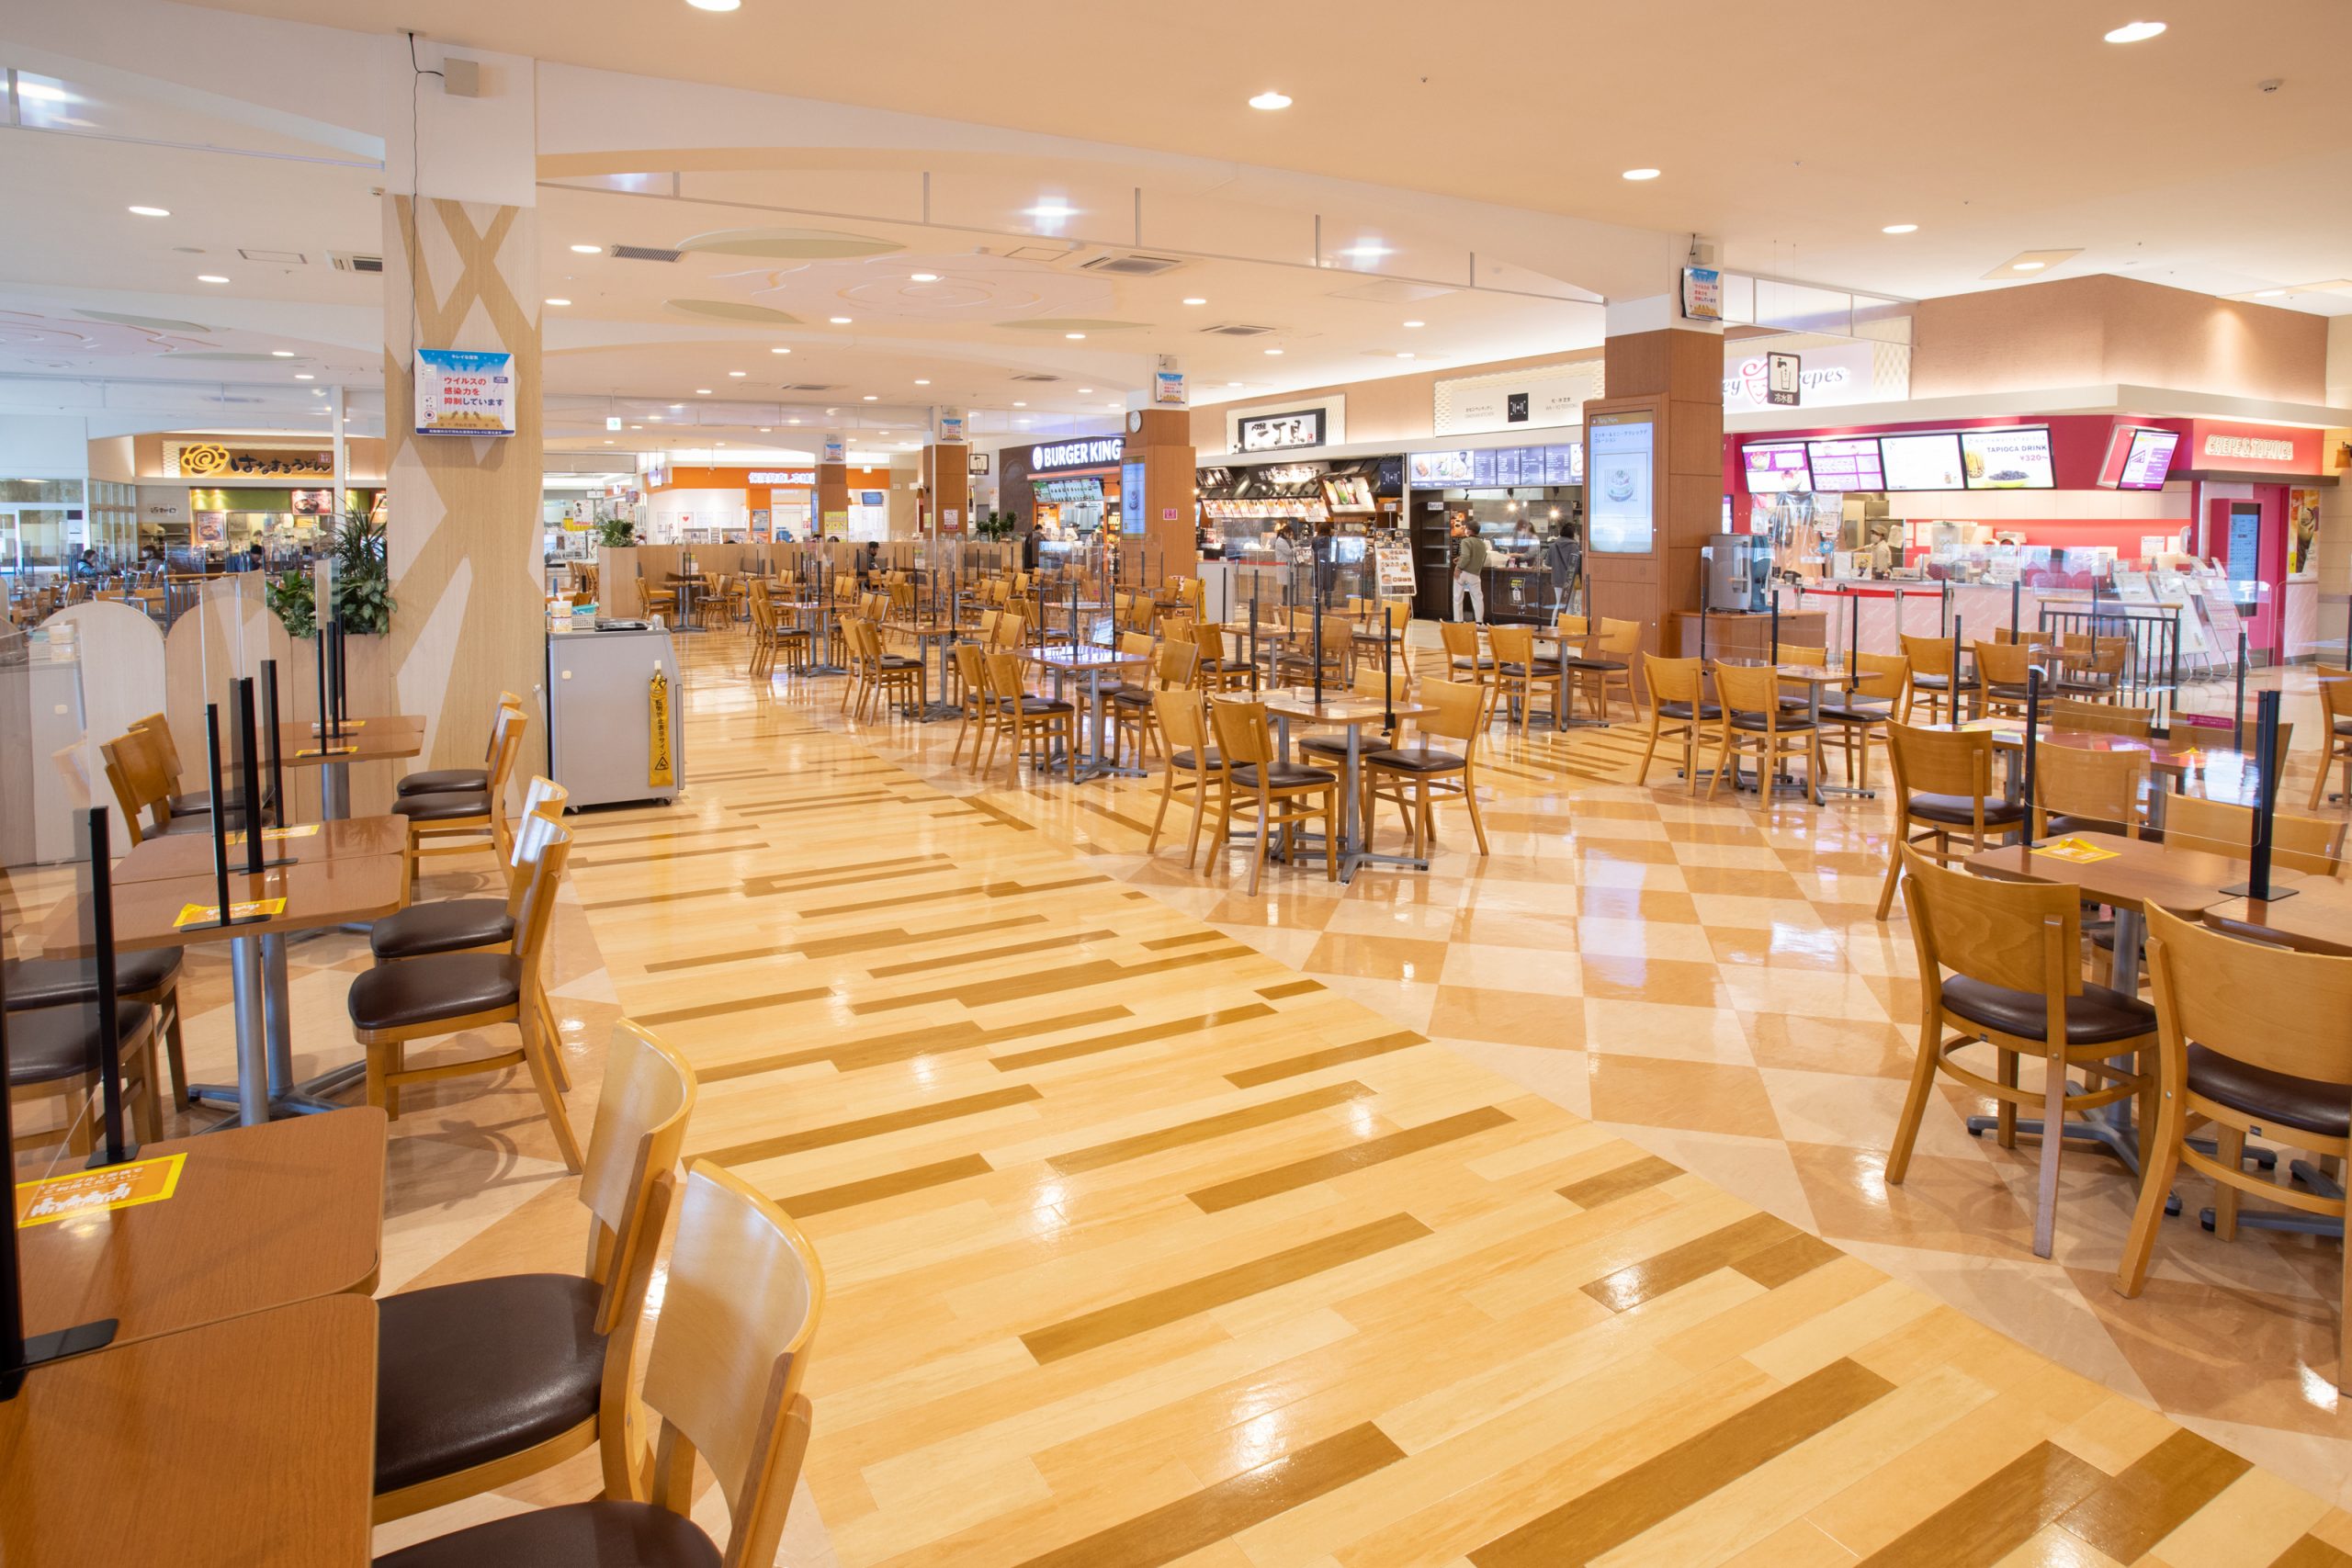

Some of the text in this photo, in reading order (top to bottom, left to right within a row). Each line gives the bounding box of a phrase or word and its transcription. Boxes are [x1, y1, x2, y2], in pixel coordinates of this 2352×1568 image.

[444, 377, 487, 387] ウイルスの
[444, 387, 480, 396] 感染力を
[444, 397, 504, 407] 抑制しています
[1774, 393, 1793, 404] 冷水器
[1044, 439, 1121, 467] BURGER KING
[231, 454, 330, 475] はなまるうどん
